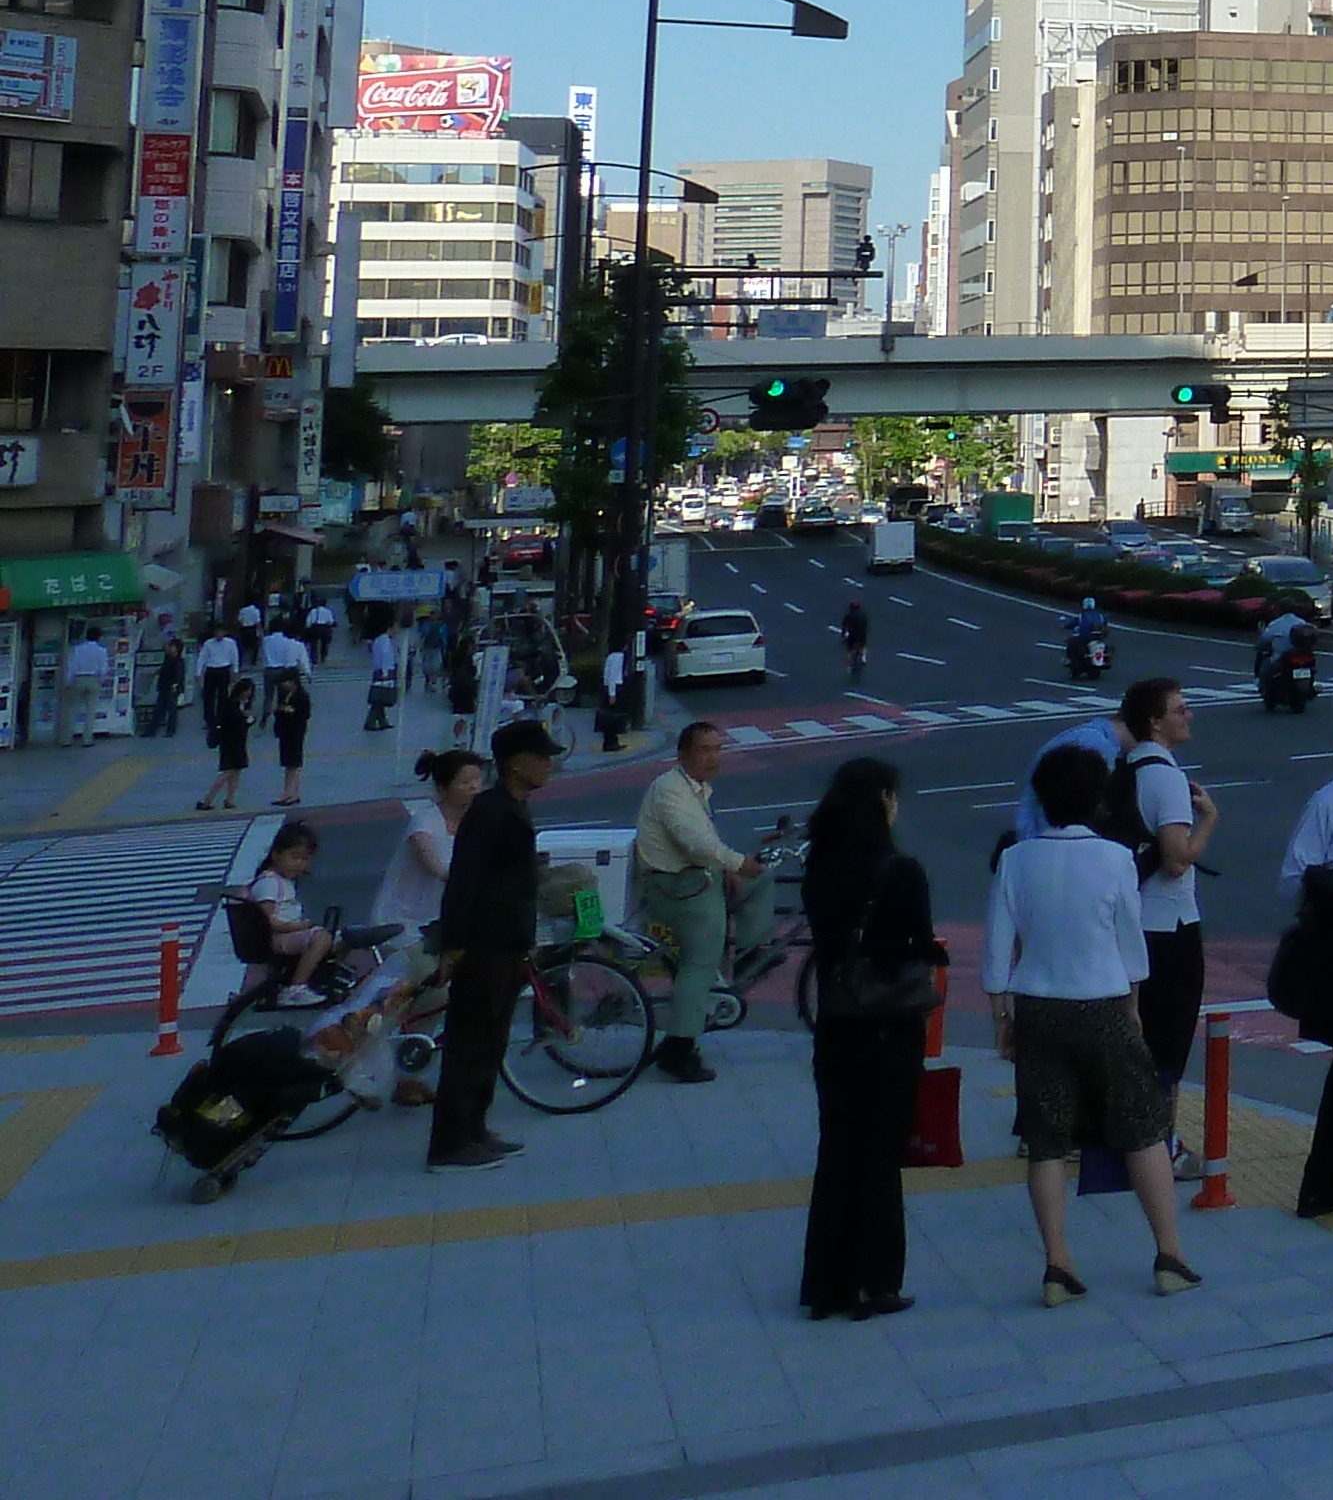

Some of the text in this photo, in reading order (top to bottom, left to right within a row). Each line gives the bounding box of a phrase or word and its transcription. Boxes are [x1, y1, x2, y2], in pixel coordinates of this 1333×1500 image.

[138, 365, 163, 377] 2F
[43, 574, 114, 594] たばこ
